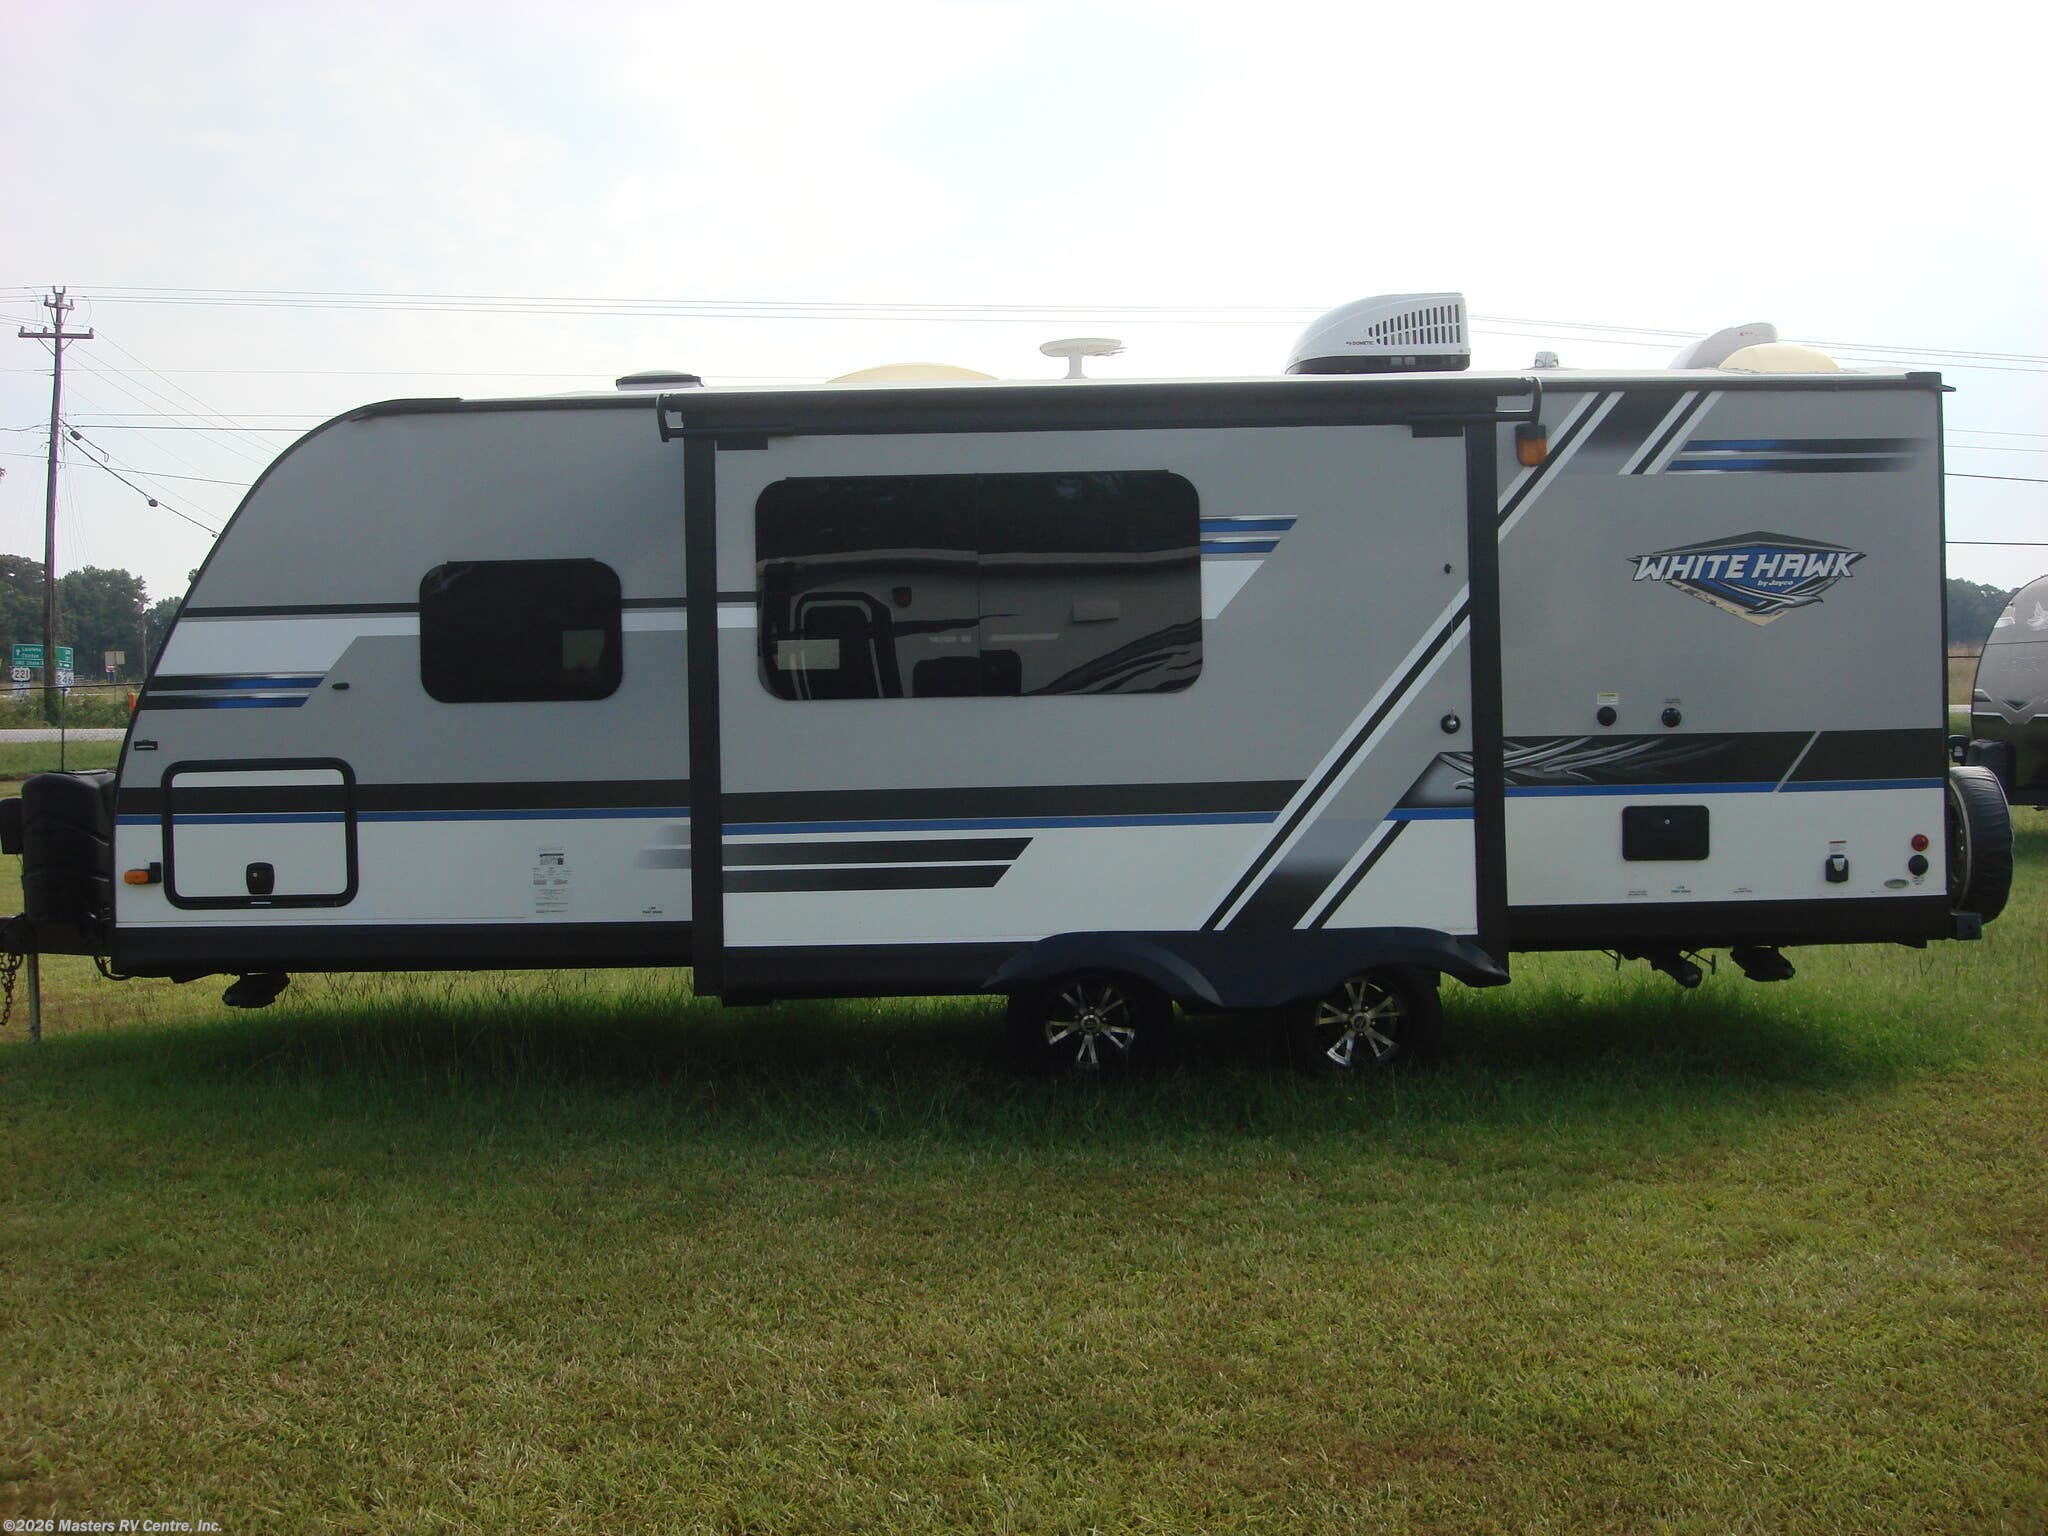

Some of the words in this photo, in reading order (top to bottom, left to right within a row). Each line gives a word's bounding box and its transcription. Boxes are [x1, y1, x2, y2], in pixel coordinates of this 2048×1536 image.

[1632, 553, 1750, 581] WHITE
[1751, 552, 1862, 578] HAWK
[14, 669, 29, 679] 221
